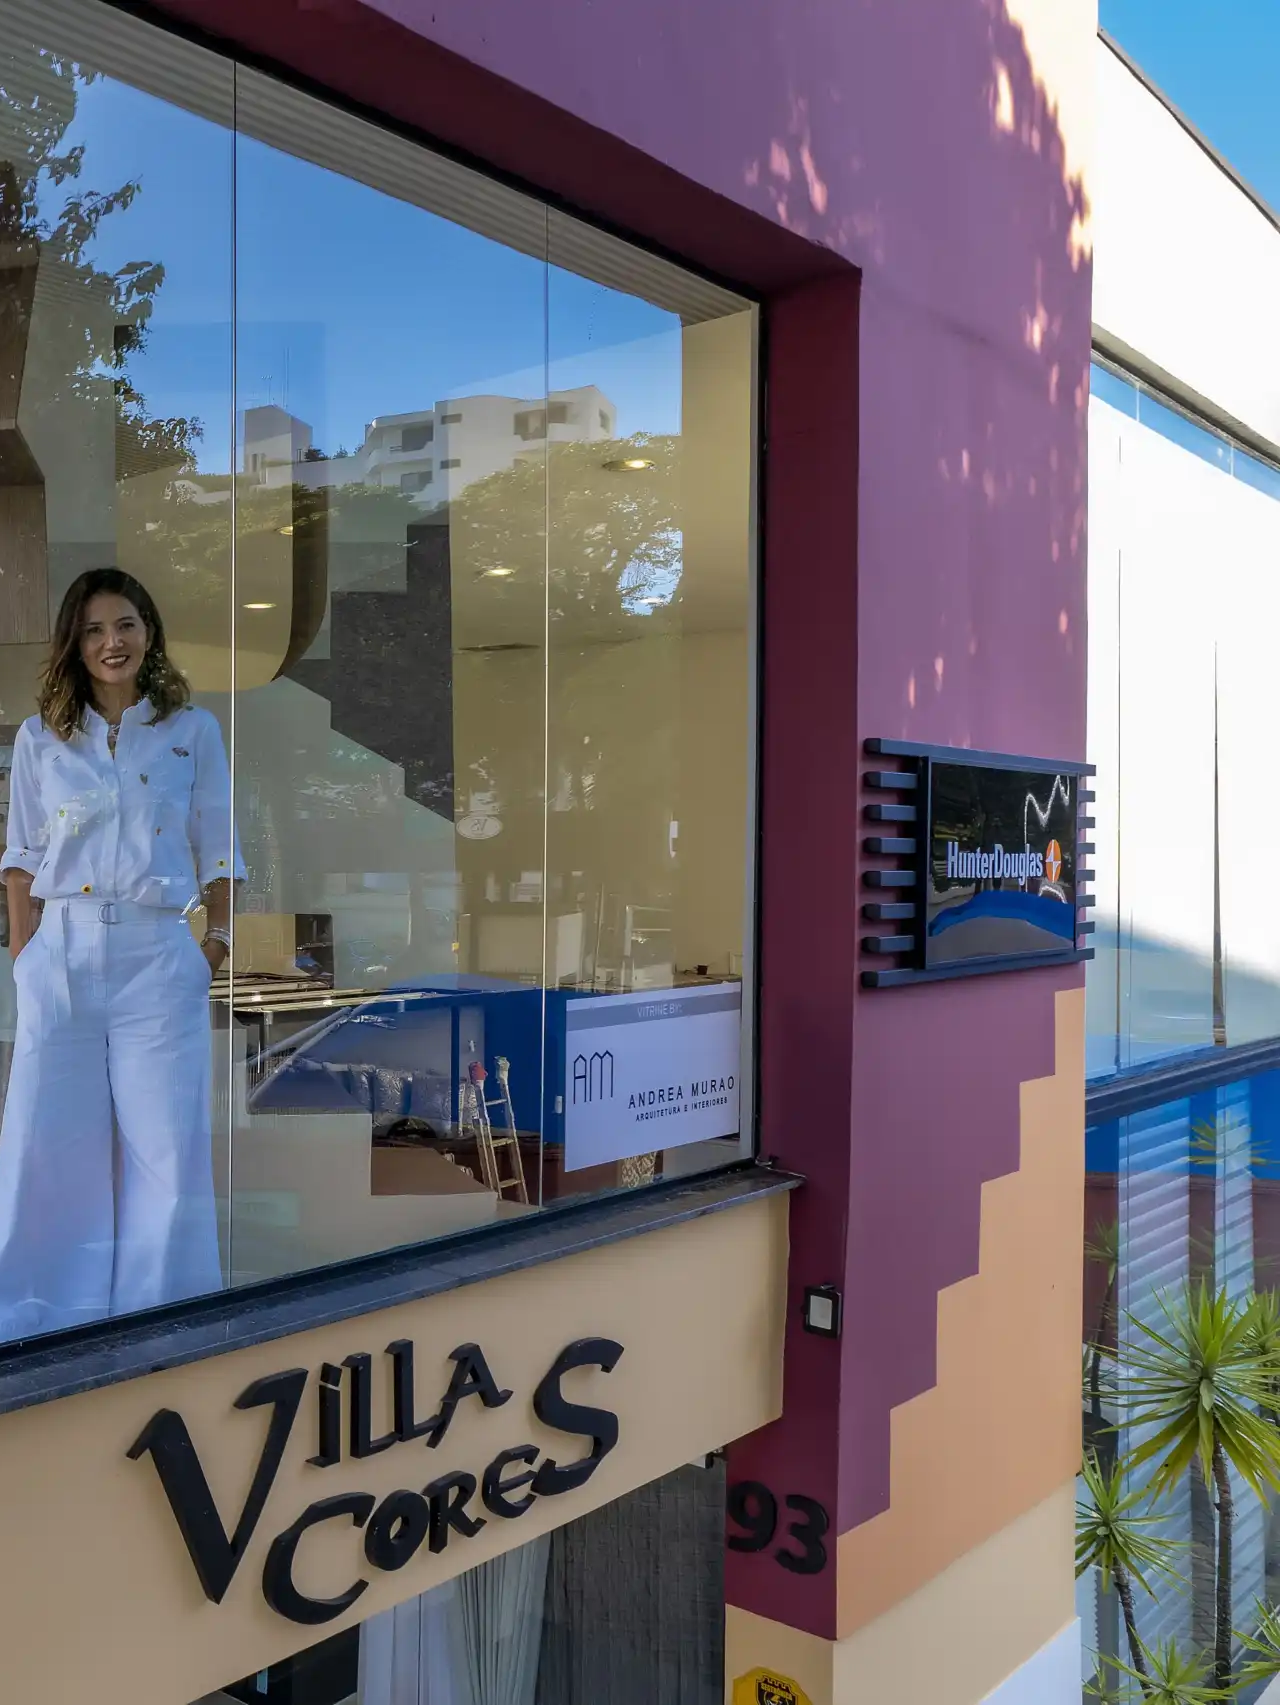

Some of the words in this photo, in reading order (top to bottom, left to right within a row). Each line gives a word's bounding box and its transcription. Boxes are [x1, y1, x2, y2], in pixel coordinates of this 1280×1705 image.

[947, 842, 1043, 885] HunterDouglas
[637, 1004, 668, 1017] VITRINE
[573, 1050, 614, 1105] AM
[628, 1085, 684, 1109] ANDREA
[691, 1075, 735, 1097] MURAO
[635, 1106, 681, 1122] ARQUITETURA
[684, 1104, 688, 1112] E
[691, 1097, 728, 1110] INTERIORES
[726, 1480, 830, 1575] 93
